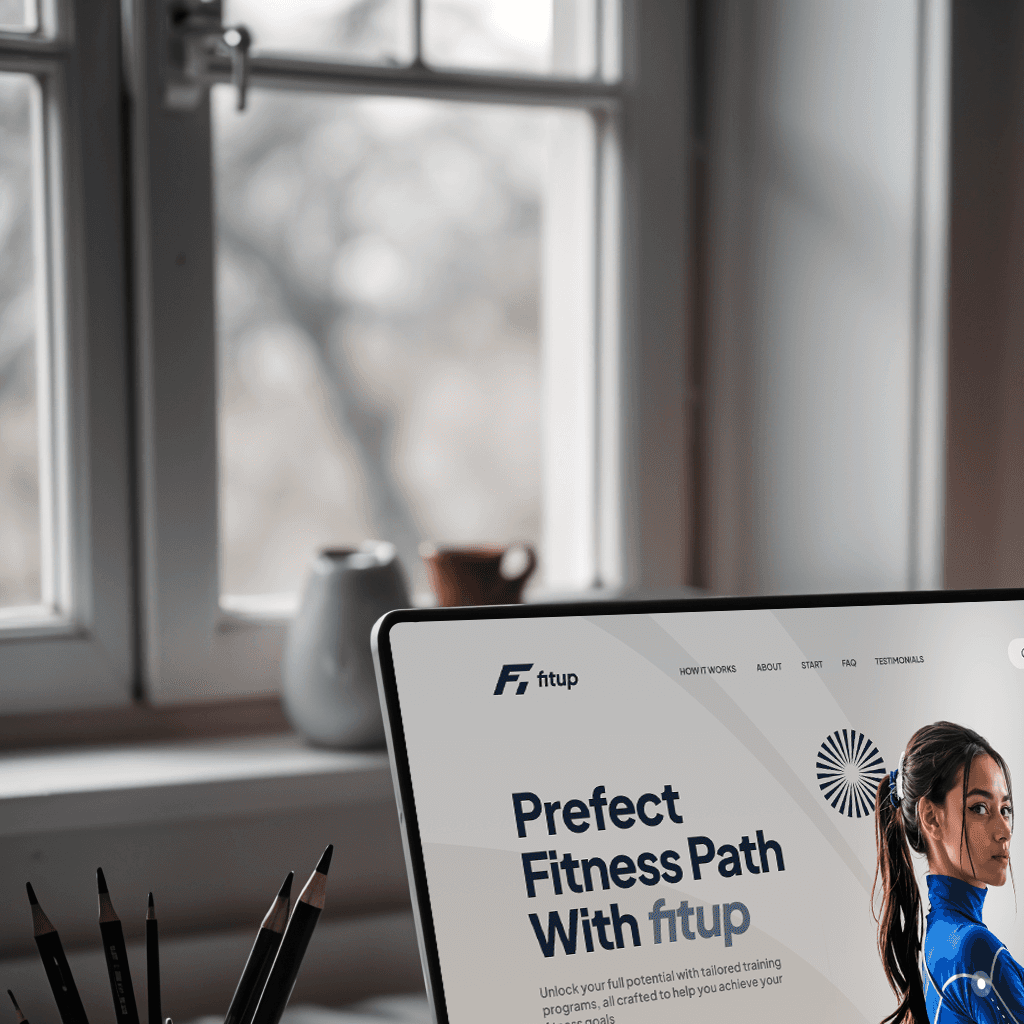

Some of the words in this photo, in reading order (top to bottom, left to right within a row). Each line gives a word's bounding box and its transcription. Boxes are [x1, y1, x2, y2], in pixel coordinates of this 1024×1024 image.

[679, 667, 699, 675] HOW
[700, 667, 706, 675] IT
[707, 665, 737, 674] WORKS
[756, 663, 782, 672] ABOUT
[801, 661, 823, 670] START
[842, 659, 856, 668] FAQ
[875, 656, 924, 665] TESTIMONIALS
[537, 670, 578, 690] fitup
[512, 785, 683, 838] Prefect
[521, 850, 683, 898] Fitness
[687, 830, 785, 880] Path
[528, 903, 641, 957] With
[648, 898, 751, 947] fitup
[540, 984, 579, 998] Unlock
[581, 982, 605, 996] your
[607, 977, 624, 990] full
[626, 971, 675, 989] potential
[676, 968, 699, 980] with
[701, 962, 741, 977] tailored
[743, 958, 781, 972] training
[543, 999, 600, 1018] programs,
[603, 996, 615, 1007] all
[617, 990, 657, 1006] crafted
[659, 990, 671, 1000] to
[673, 984, 696, 999] help
[697, 984, 717, 997] you
[718, 978, 758, 992] achieve
[760, 975, 783, 988] your
